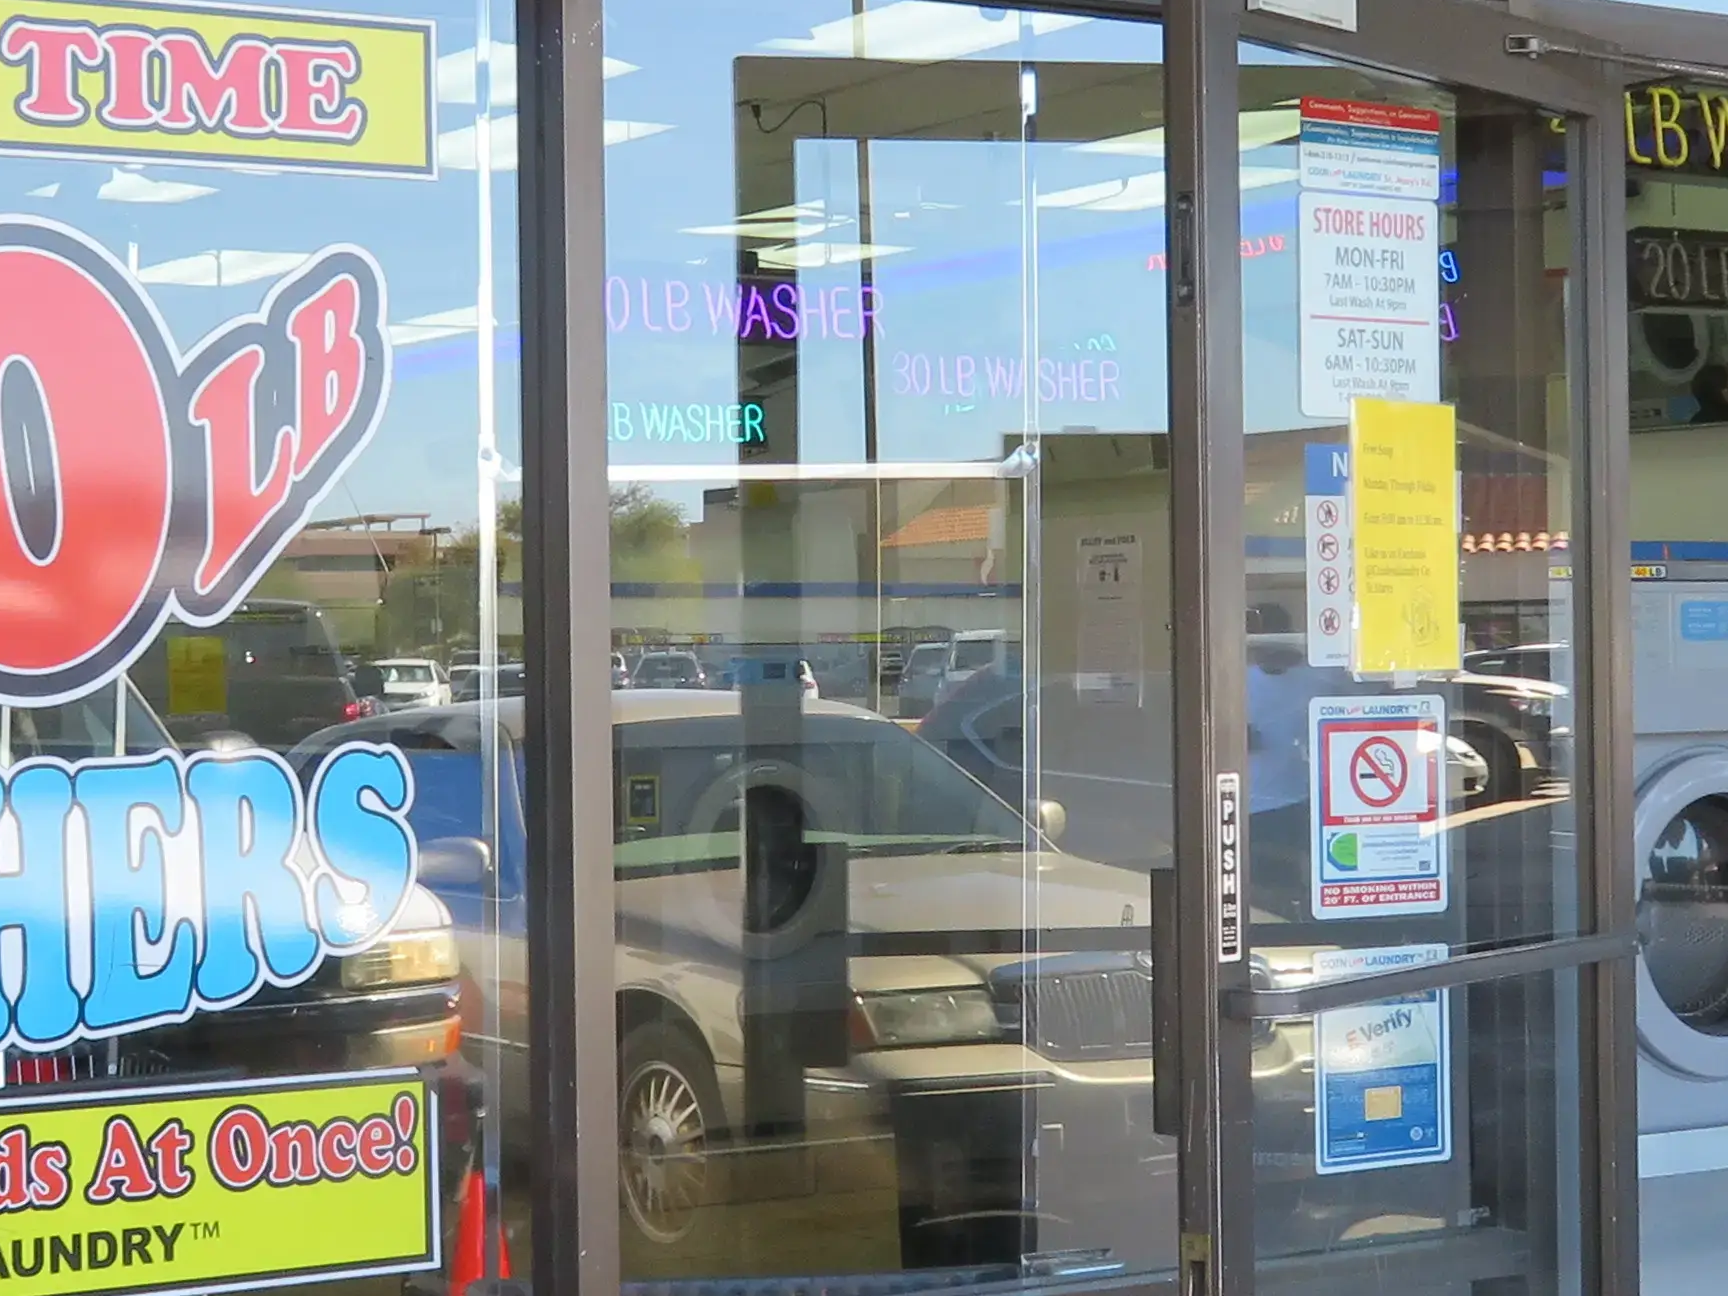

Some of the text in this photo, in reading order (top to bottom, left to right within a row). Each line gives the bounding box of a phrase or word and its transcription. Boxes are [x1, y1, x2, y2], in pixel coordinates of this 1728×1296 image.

[1624, 86, 1688, 167] LB
[1313, 208, 1426, 241] STORE HOURS
[1335, 247, 1405, 271] MON-FRI
[1643, 240, 1691, 300] 20
[1324, 273, 1354, 289] 7AM
[1363, 276, 1416, 295] 10:30PM
[641, 278, 693, 333] LB
[702, 282, 886, 341] WASHER
[1329, 295, 1348, 308] Last
[1349, 296, 1372, 309] Wash
[1337, 328, 1404, 351] SAT-SUN
[892, 350, 931, 397] 30
[939, 355, 975, 398] LB
[1325, 357, 1354, 372] 6AM
[1364, 357, 1416, 375] 10:30PM
[180, 254, 382, 616] LB
[639, 402, 766, 444] WASHER
[1320, 706, 1345, 716] COIN
[1362, 704, 1410, 715] LAUNDRY
[1222, 799, 1236, 895] PUSH
[1324, 881, 1437, 896] NO SMOKING WITHIN
[1362, 894, 1376, 903] OF
[1379, 891, 1436, 902] ENTRANCE
[1365, 953, 1416, 966] LAUNDRY
[1360, 1008, 1413, 1042] Verify
[85, 1113, 196, 1204] At
[207, 1090, 419, 1192] Once!
